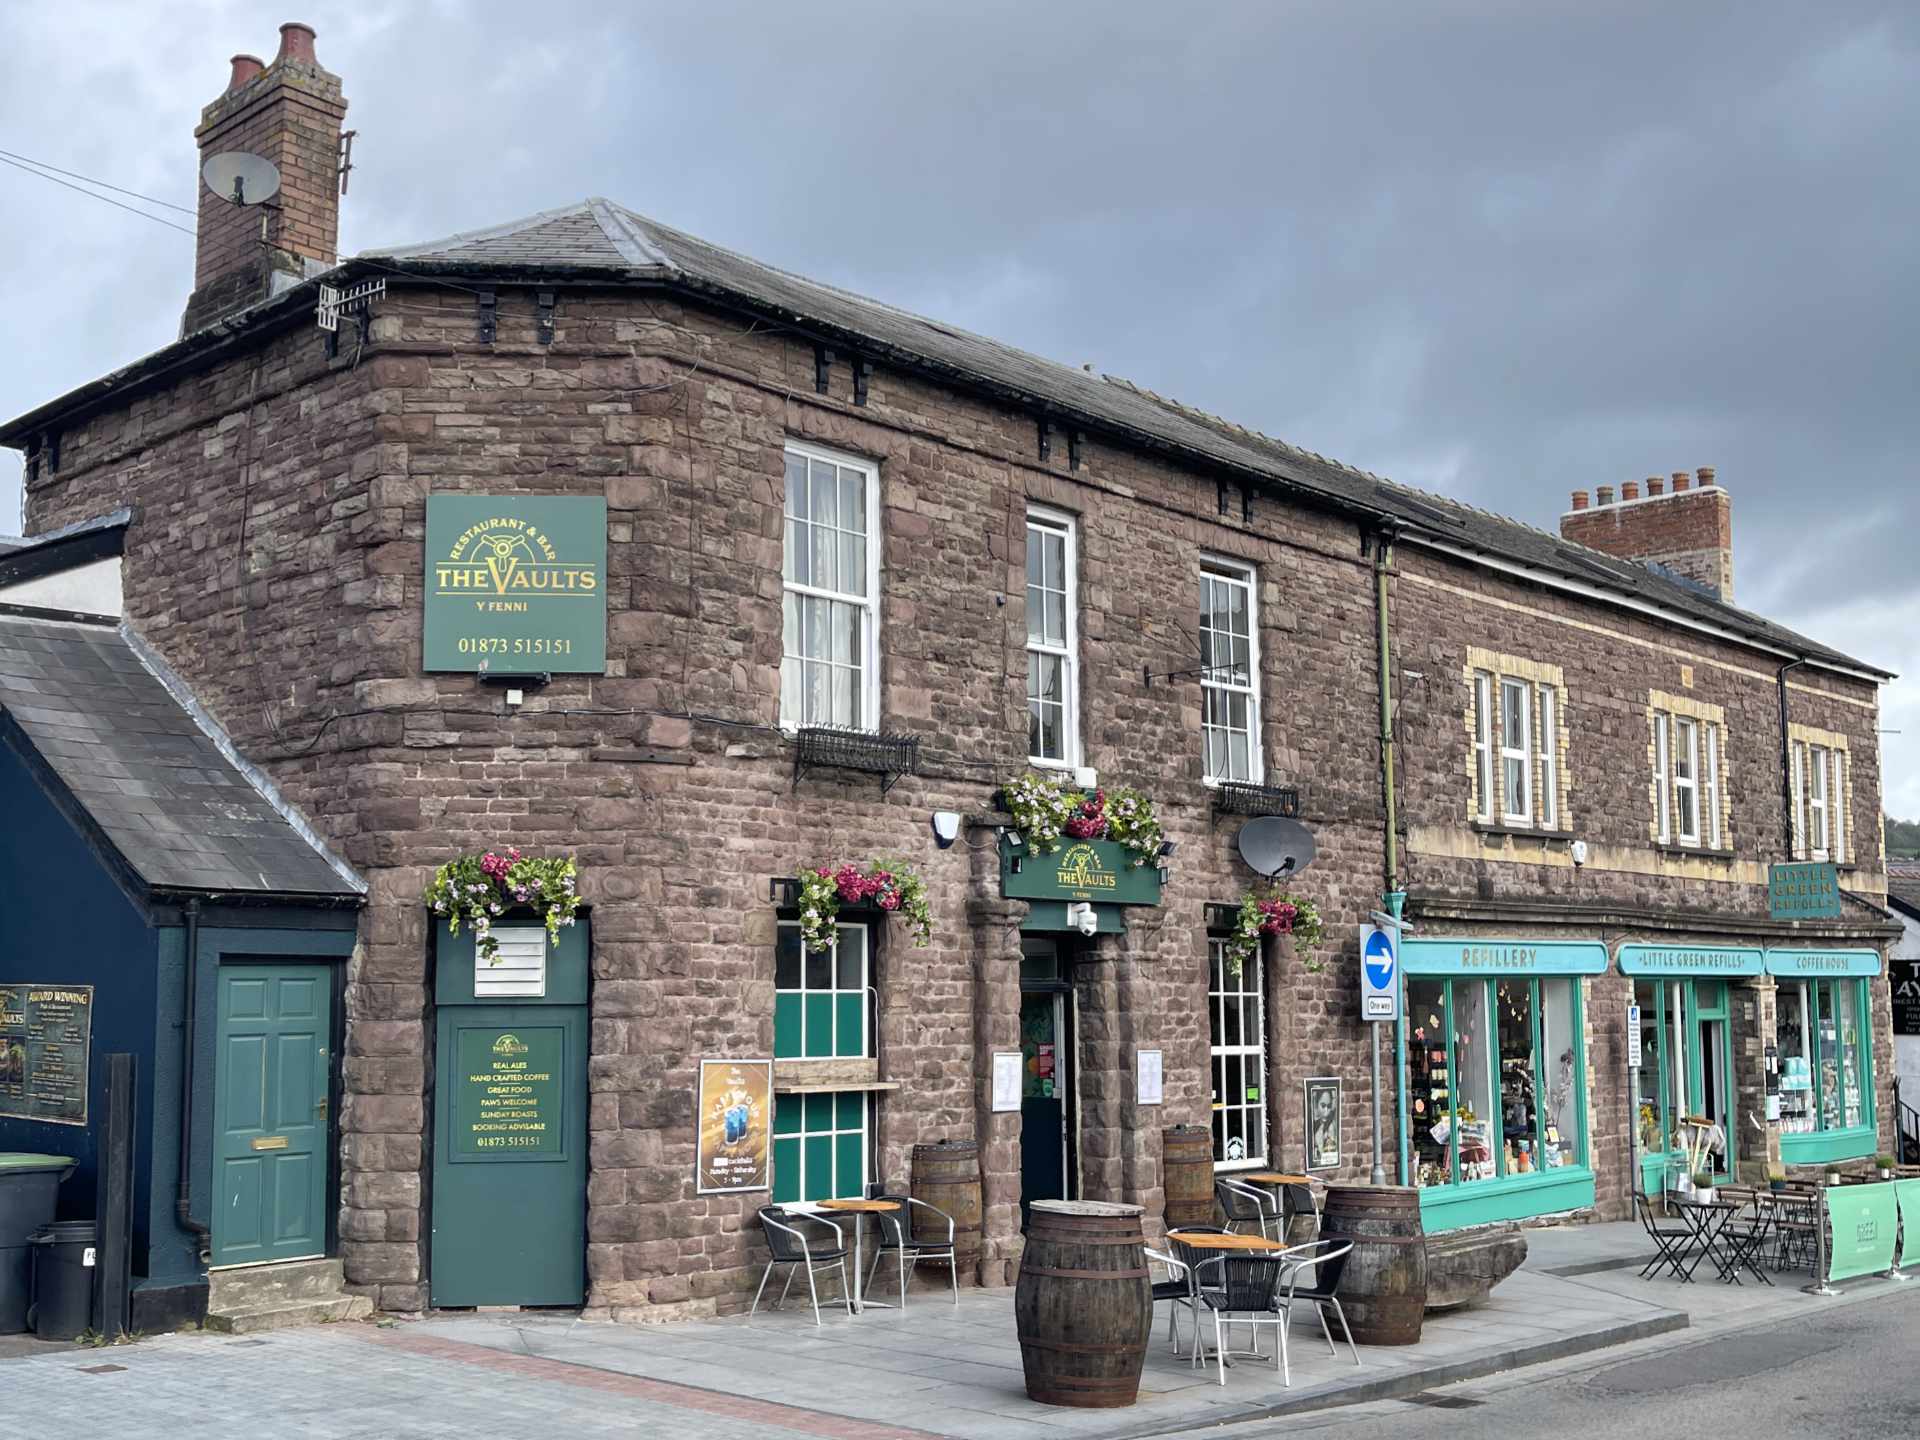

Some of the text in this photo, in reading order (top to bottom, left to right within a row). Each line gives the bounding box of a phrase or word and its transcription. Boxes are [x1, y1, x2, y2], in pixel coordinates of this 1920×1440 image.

[450, 518, 556, 561] RESTAURANT & BAR
[436, 557, 597, 595] THE VAULTS
[476, 602, 528, 612] Y FENNI
[458, 638, 571, 654] 01873 515151
[1057, 865, 1117, 888] THE VAULTS
[1462, 947, 1537, 968] REFILLERY
[1643, 952, 1742, 968] LITTLE GREEN REFILLS
[1796, 957, 1848, 969] COFFEE HOUSE
[29, 991, 54, 1003] AWARD
[54, 991, 88, 1005] WINNING
[1370, 1000, 1380, 1009] One
[493, 1074, 523, 1082] CRAFTED
[524, 1073, 550, 1081] COFFEE
[487, 1086, 510, 1094] GREAT
[511, 1110, 538, 1118] ROASTS
[508, 1123, 546, 1131] ADVISABLE
[477, 1136, 541, 1147] 01873 515151
